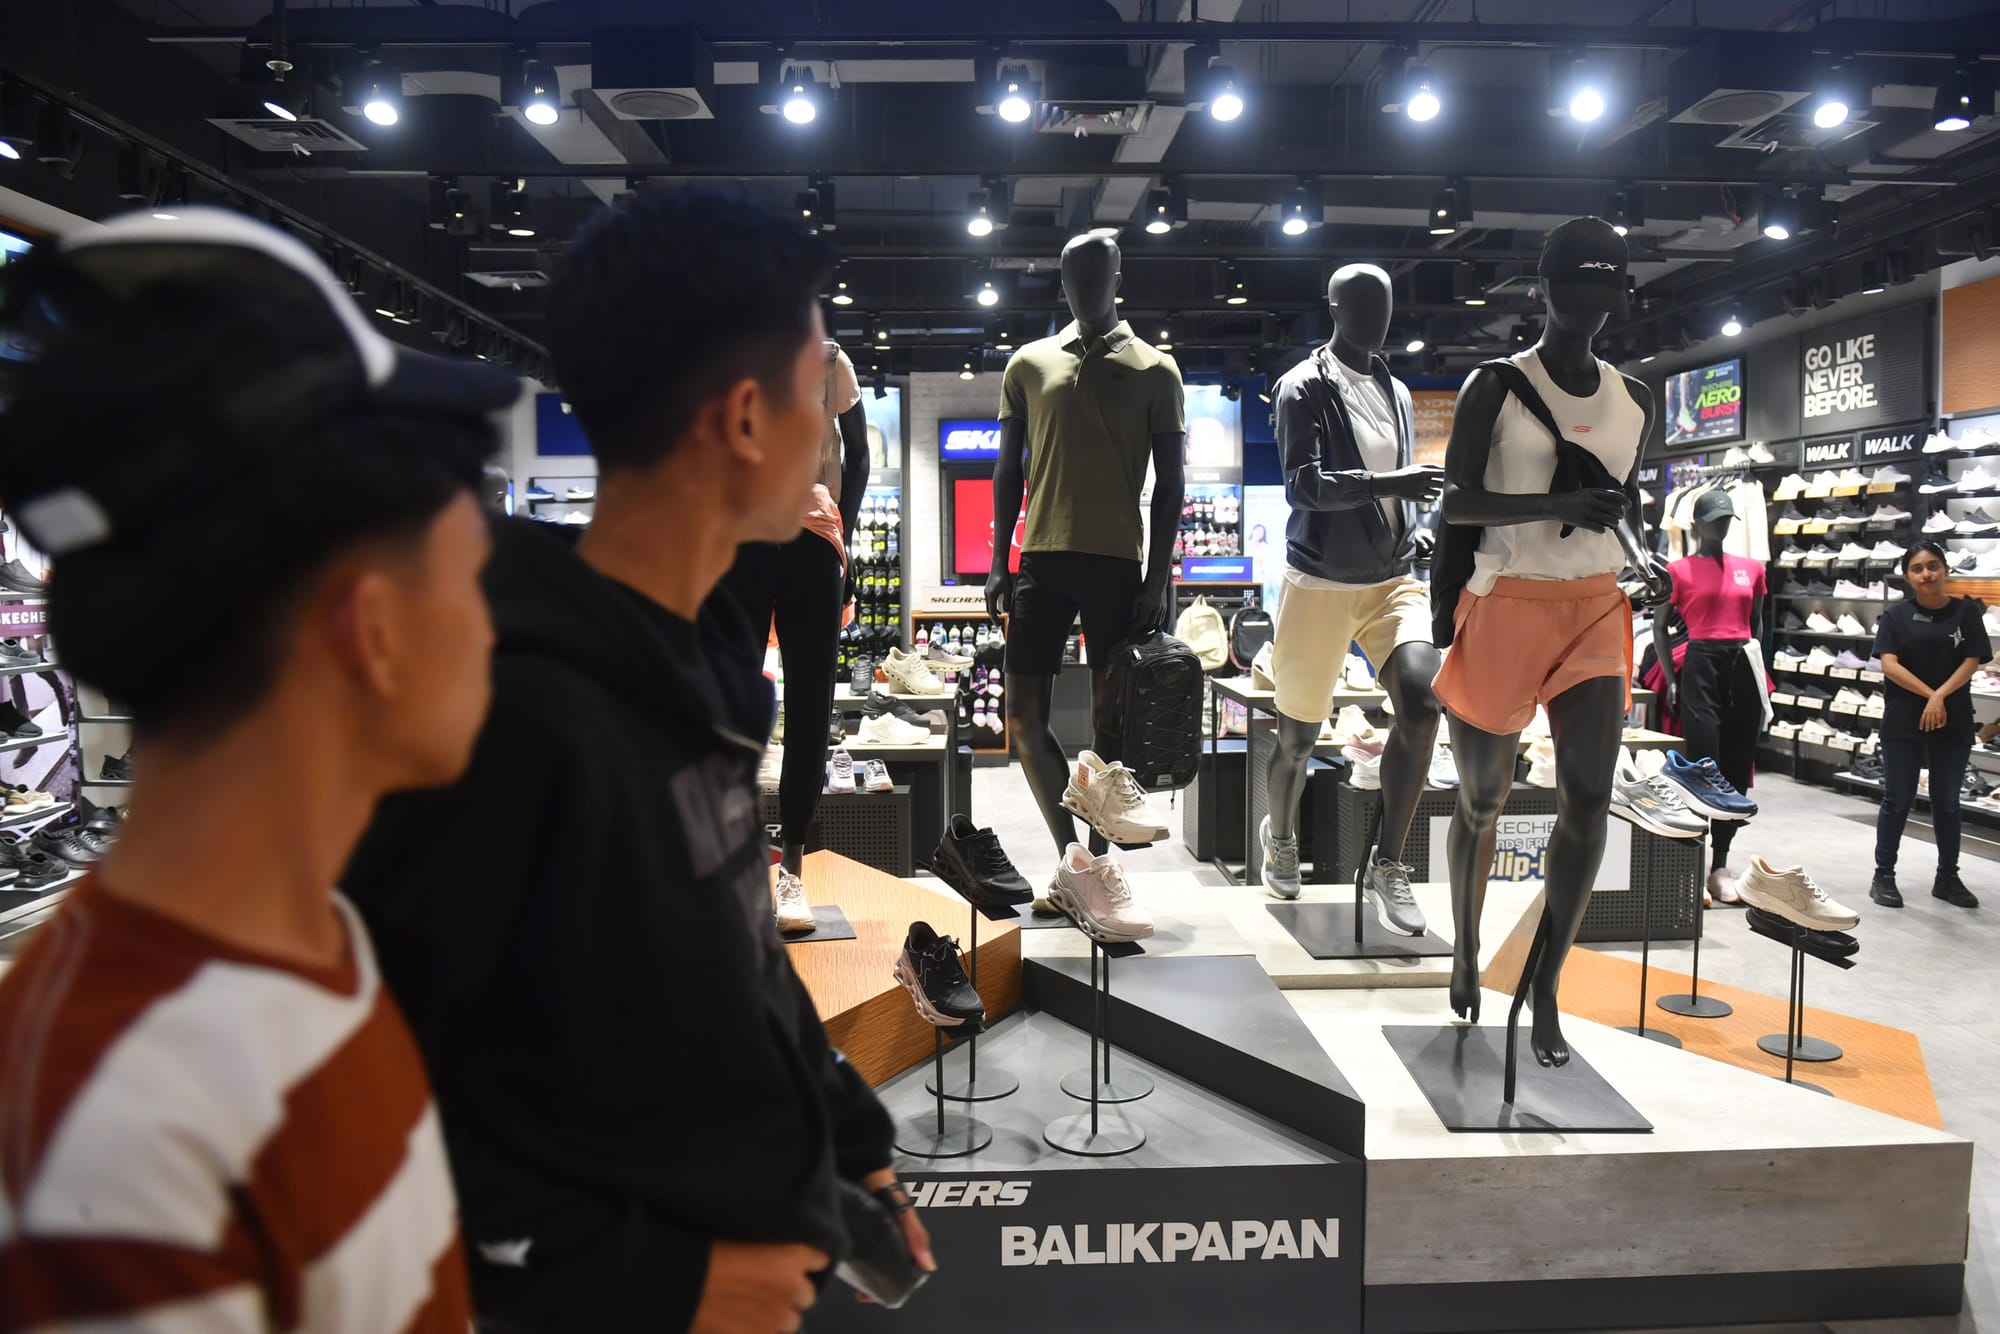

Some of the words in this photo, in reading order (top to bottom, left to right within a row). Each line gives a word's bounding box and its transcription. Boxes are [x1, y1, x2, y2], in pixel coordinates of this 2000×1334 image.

[1805, 345, 1832, 370] GO
[1836, 334, 1875, 364] LIKE
[1804, 362, 1864, 394] NEVER
[1694, 385, 1741, 410] AERO
[1700, 400, 1741, 419] BURST
[1804, 383, 1878, 418] BEFORE.
[1806, 442, 1851, 462] WALK
[1864, 434, 1915, 455] WALK
[0, 611, 47, 624] KECHE
[1001, 1218, 1340, 1266] BALIKPAPAN
